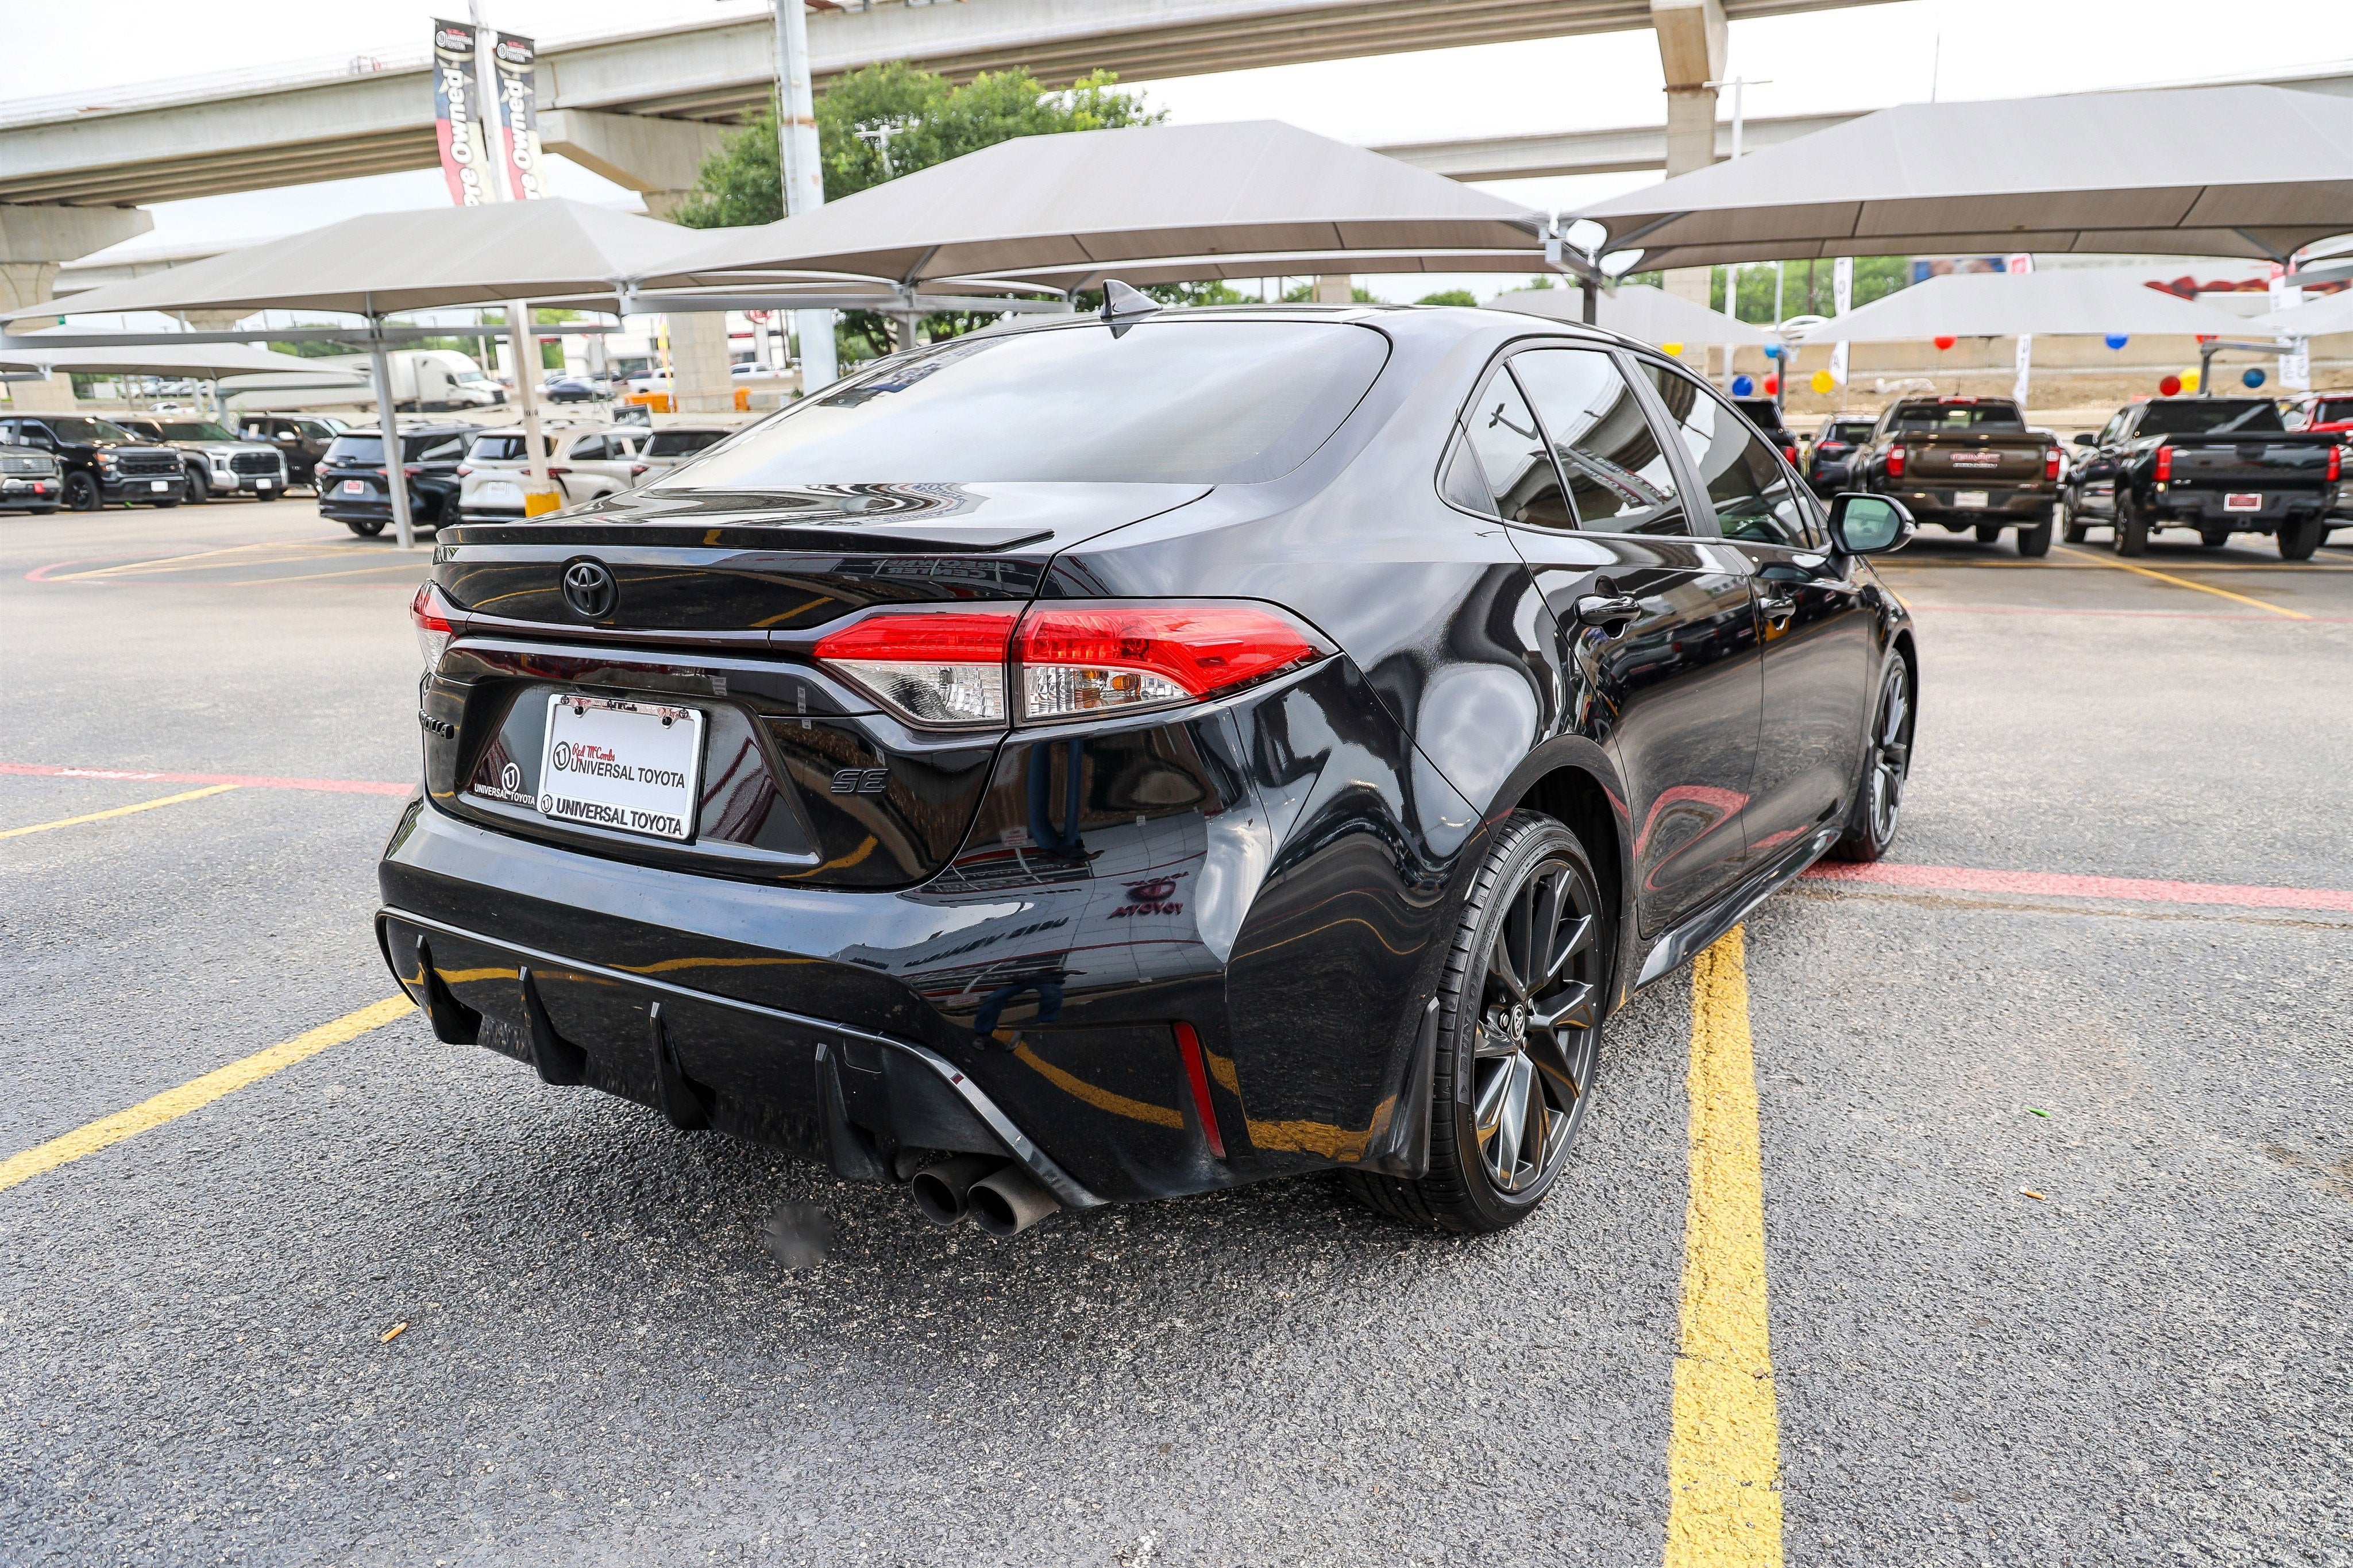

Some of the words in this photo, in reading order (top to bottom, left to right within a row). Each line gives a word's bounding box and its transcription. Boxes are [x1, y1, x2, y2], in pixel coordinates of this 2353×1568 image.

[443, 68, 473, 164] Owned
[503, 78, 533, 171] Owned
[520, 172, 541, 200] re
[572, 743, 585, 761] Red
[587, 745, 615, 762] McCombs
[570, 758, 634, 781] UNIVERSAL
[638, 767, 686, 789] TOYOTA
[831, 768, 889, 793] SE
[474, 783, 508, 800] UNIVERSAL
[510, 791, 535, 805] TOYOTA
[557, 798, 628, 826] UNIVERSAL
[631, 810, 684, 836] TOYOTA
[1460, 963, 1480, 1075] DUNLOP
